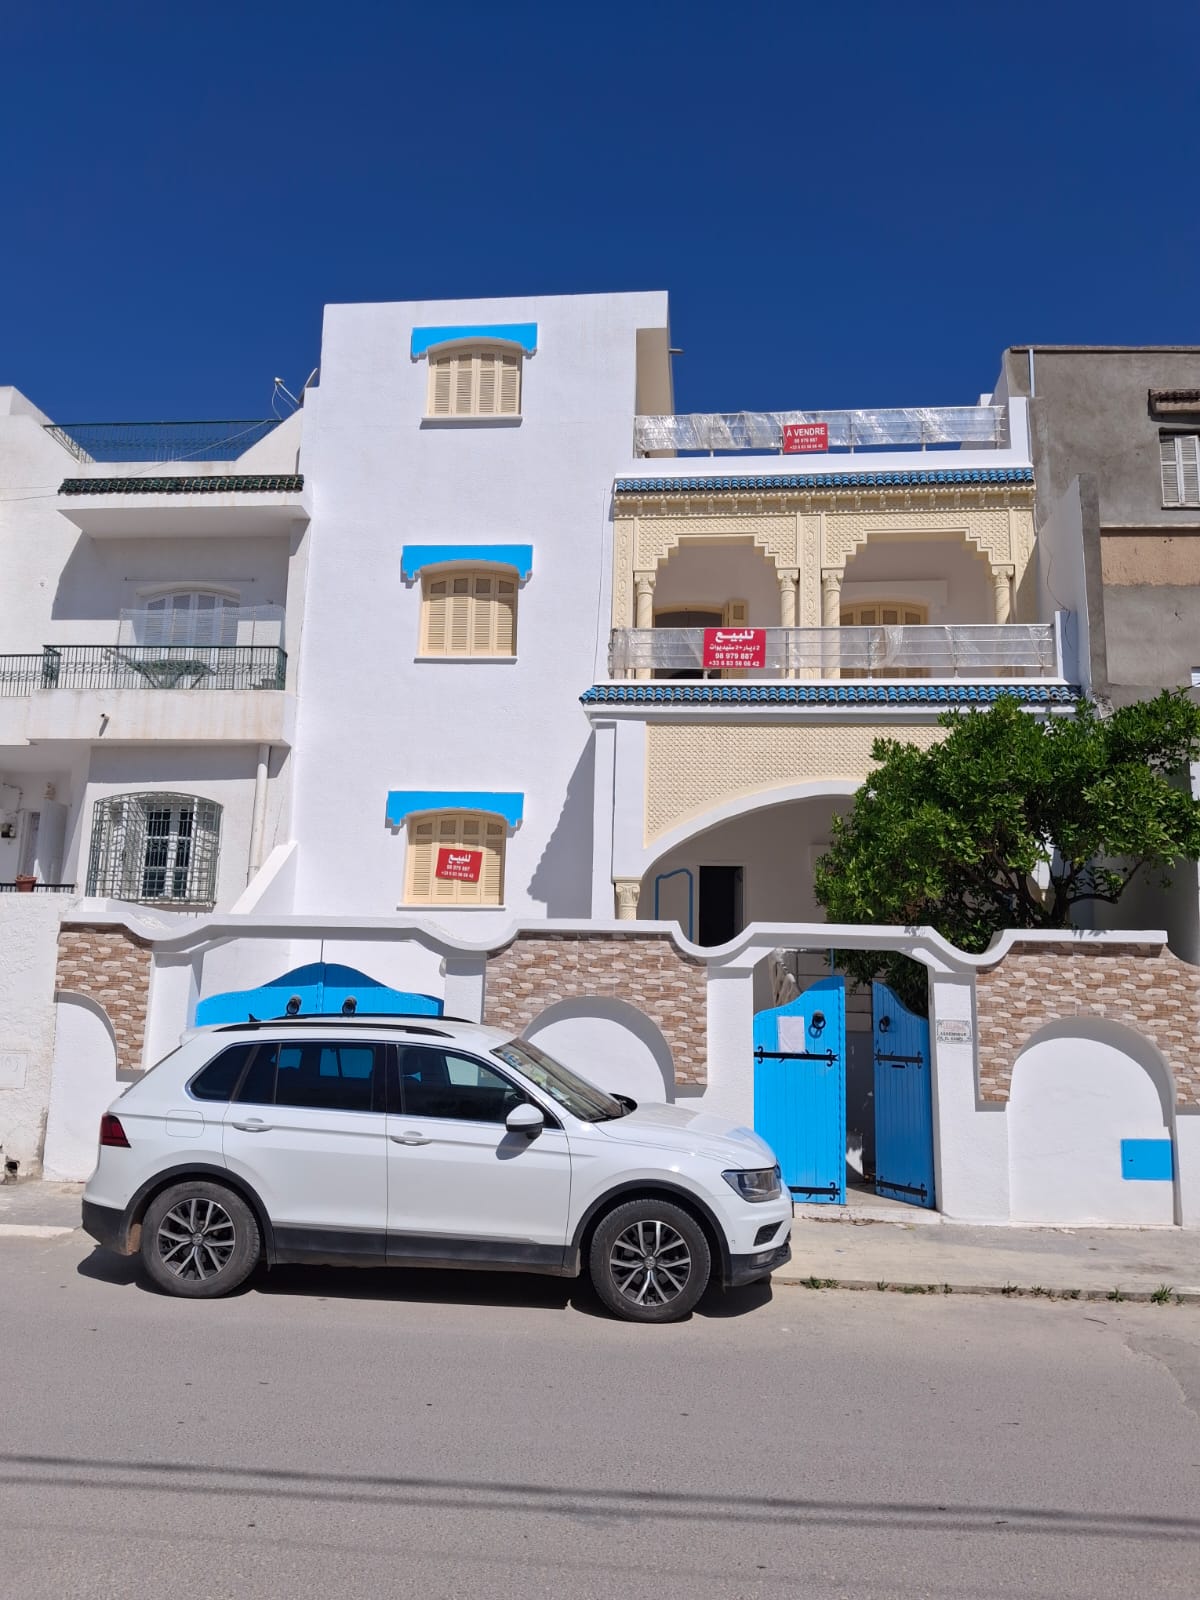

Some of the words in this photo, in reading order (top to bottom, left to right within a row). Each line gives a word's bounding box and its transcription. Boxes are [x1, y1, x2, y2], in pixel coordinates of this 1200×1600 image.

[794, 427, 825, 436] VENDRE
[715, 630, 754, 642] للبيع
[448, 853, 471, 864] للبيع
